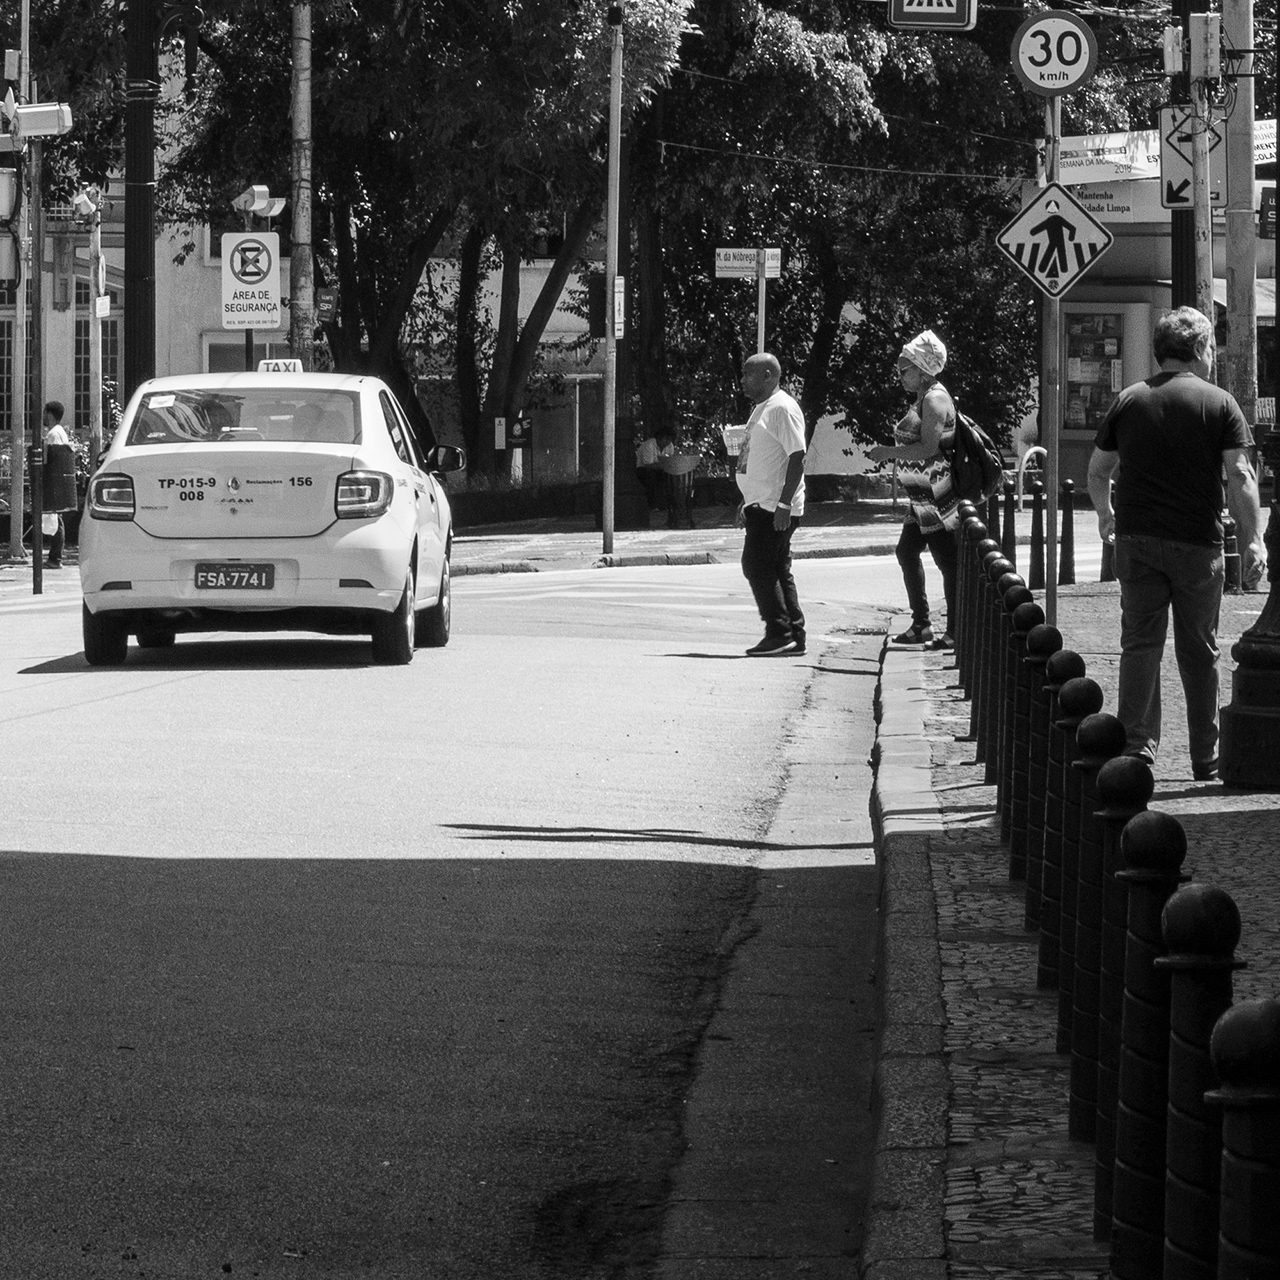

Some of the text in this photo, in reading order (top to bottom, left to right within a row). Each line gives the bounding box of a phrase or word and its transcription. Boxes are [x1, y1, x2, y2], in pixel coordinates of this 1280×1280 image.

[1028, 29, 1082, 67] 30
[1039, 71, 1069, 81] km/h
[1060, 159, 1084, 169] SEMANA
[1077, 191, 1114, 200] Mantenha
[1107, 204, 1131, 214] Limpa
[232, 288, 270, 300] ÁREA DE
[224, 302, 278, 314] SEGURANÇA
[263, 362, 297, 372] TAXI
[158, 477, 216, 489] TP-015-9
[289, 477, 313, 487] 156
[179, 491, 205, 501] 008
